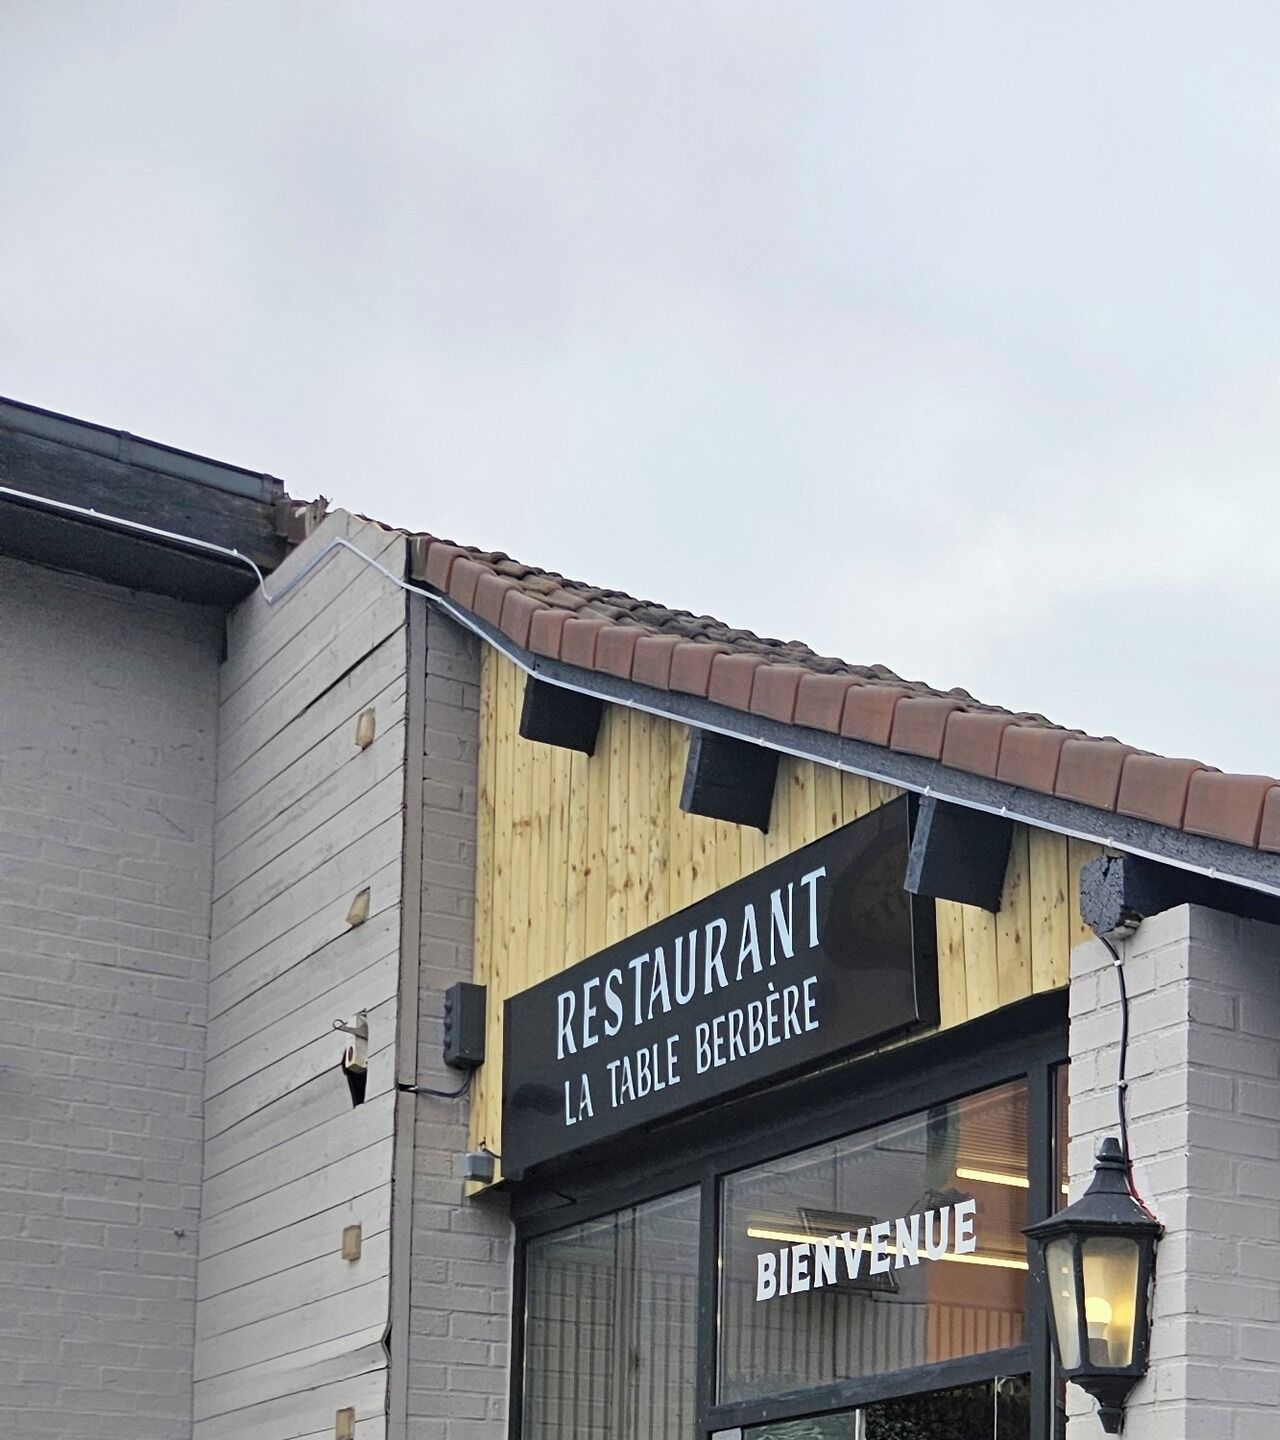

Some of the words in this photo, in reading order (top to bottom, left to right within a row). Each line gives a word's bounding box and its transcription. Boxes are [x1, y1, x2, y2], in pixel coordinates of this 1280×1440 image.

[556, 866, 826, 1060] RESTAURANT
[564, 1073, 594, 1126] LA
[607, 1034, 681, 1108] TABLE
[695, 976, 819, 1075] BERBÈRE
[755, 1198, 977, 1302] BIENVENUE
